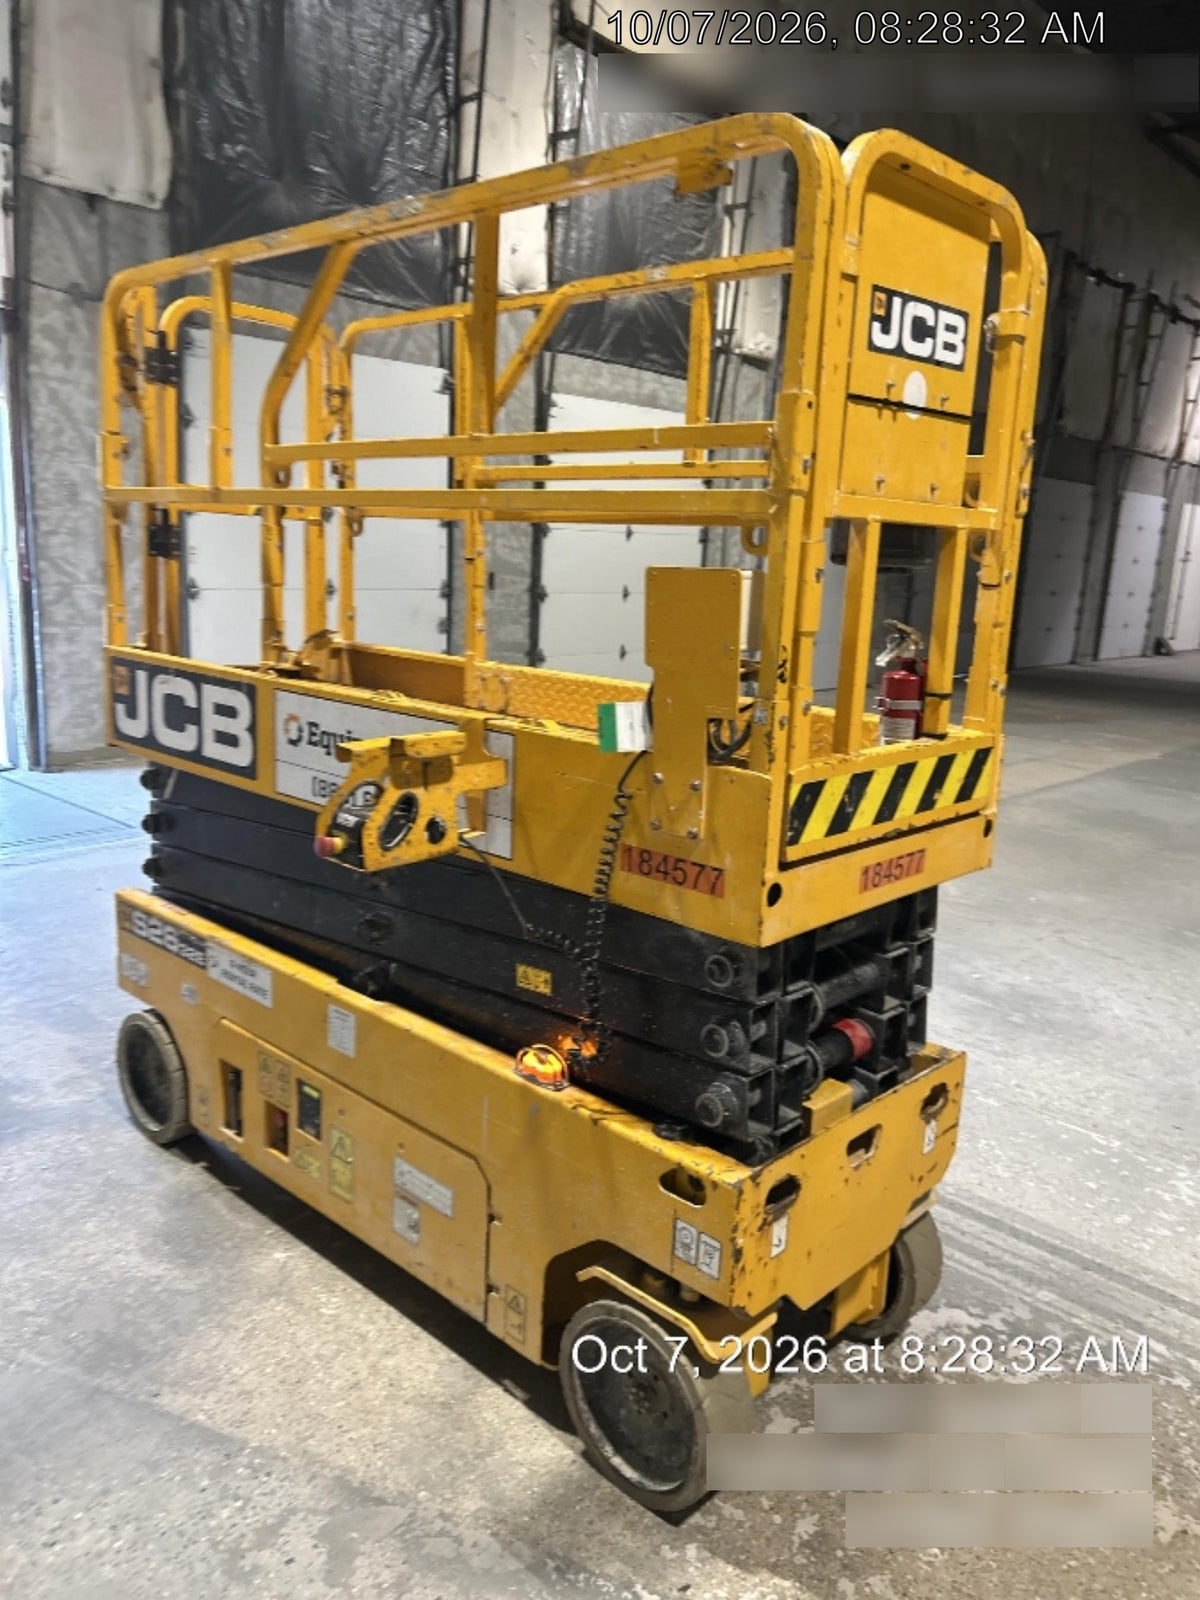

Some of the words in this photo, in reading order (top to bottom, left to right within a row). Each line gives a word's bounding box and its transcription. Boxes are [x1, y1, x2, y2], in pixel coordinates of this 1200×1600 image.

[871, 296, 966, 365] JCB
[114, 669, 254, 767] JCB
[623, 847, 724, 895] 184577
[861, 848, 926, 892] 184577
